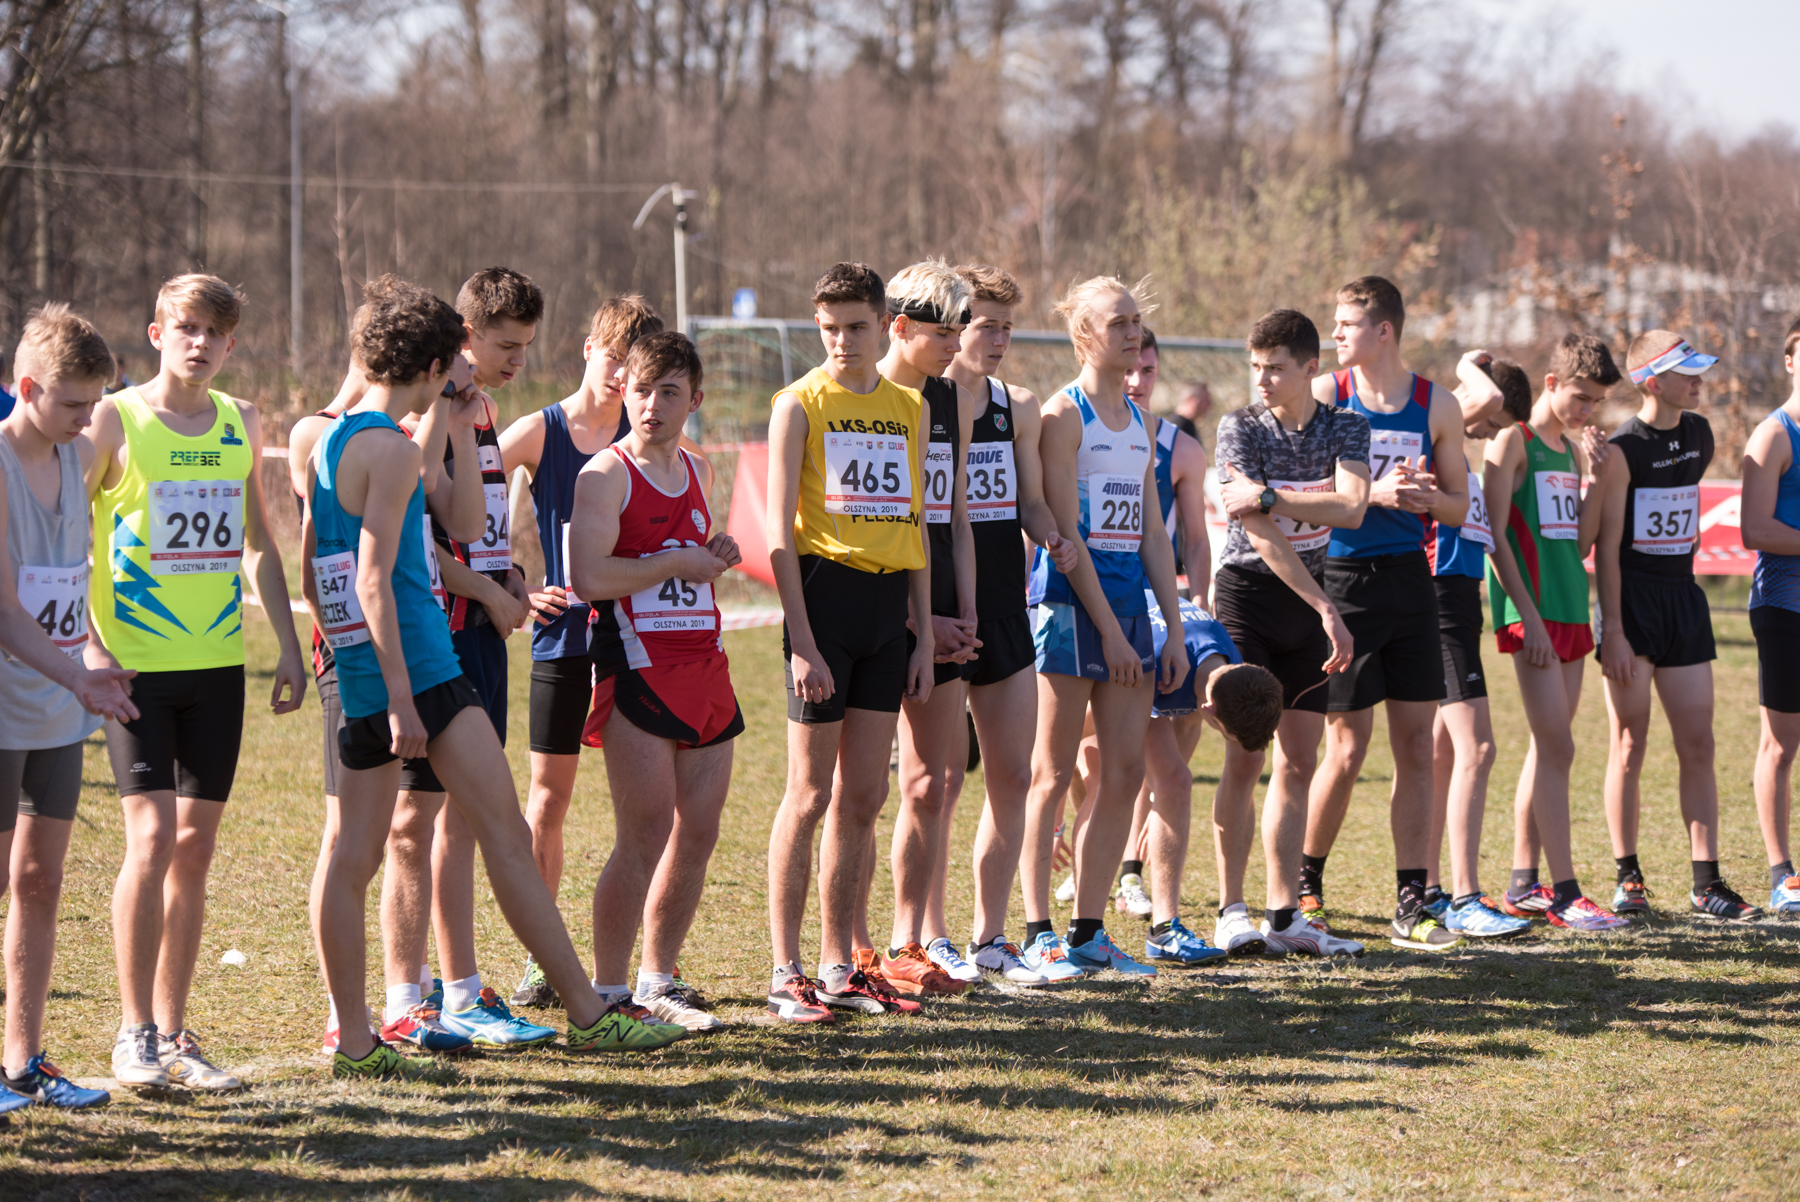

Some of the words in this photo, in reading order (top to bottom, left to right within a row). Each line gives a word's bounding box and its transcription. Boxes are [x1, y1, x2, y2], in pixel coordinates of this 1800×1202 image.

[894, 442, 905, 451] LUG
[1408, 439, 1419, 447] LUG
[967, 450, 1004, 465] MOVE
[841, 459, 900, 494] 465
[230, 488, 241, 497] LUG
[1102, 482, 1141, 496] 4MOVE
[843, 505, 877, 513] OLSZYNA
[881, 505, 898, 513] 2019
[1551, 495, 1579, 521] 10
[929, 513, 943, 521] 2019
[968, 511, 990, 520] SZYNA
[1101, 500, 1140, 532] 228
[1646, 509, 1692, 538] 357
[166, 511, 231, 549] 296
[1101, 542, 1126, 550] OLSZYNA
[1647, 545, 1676, 554] OLSZYNA
[171, 563, 206, 572] OLSZYNA
[209, 562, 228, 571] 2019
[336, 561, 351, 572] LUG
[321, 575, 348, 596] 547
[653, 620, 687, 629] OLSZYNA
[690, 620, 705, 628] 2019
